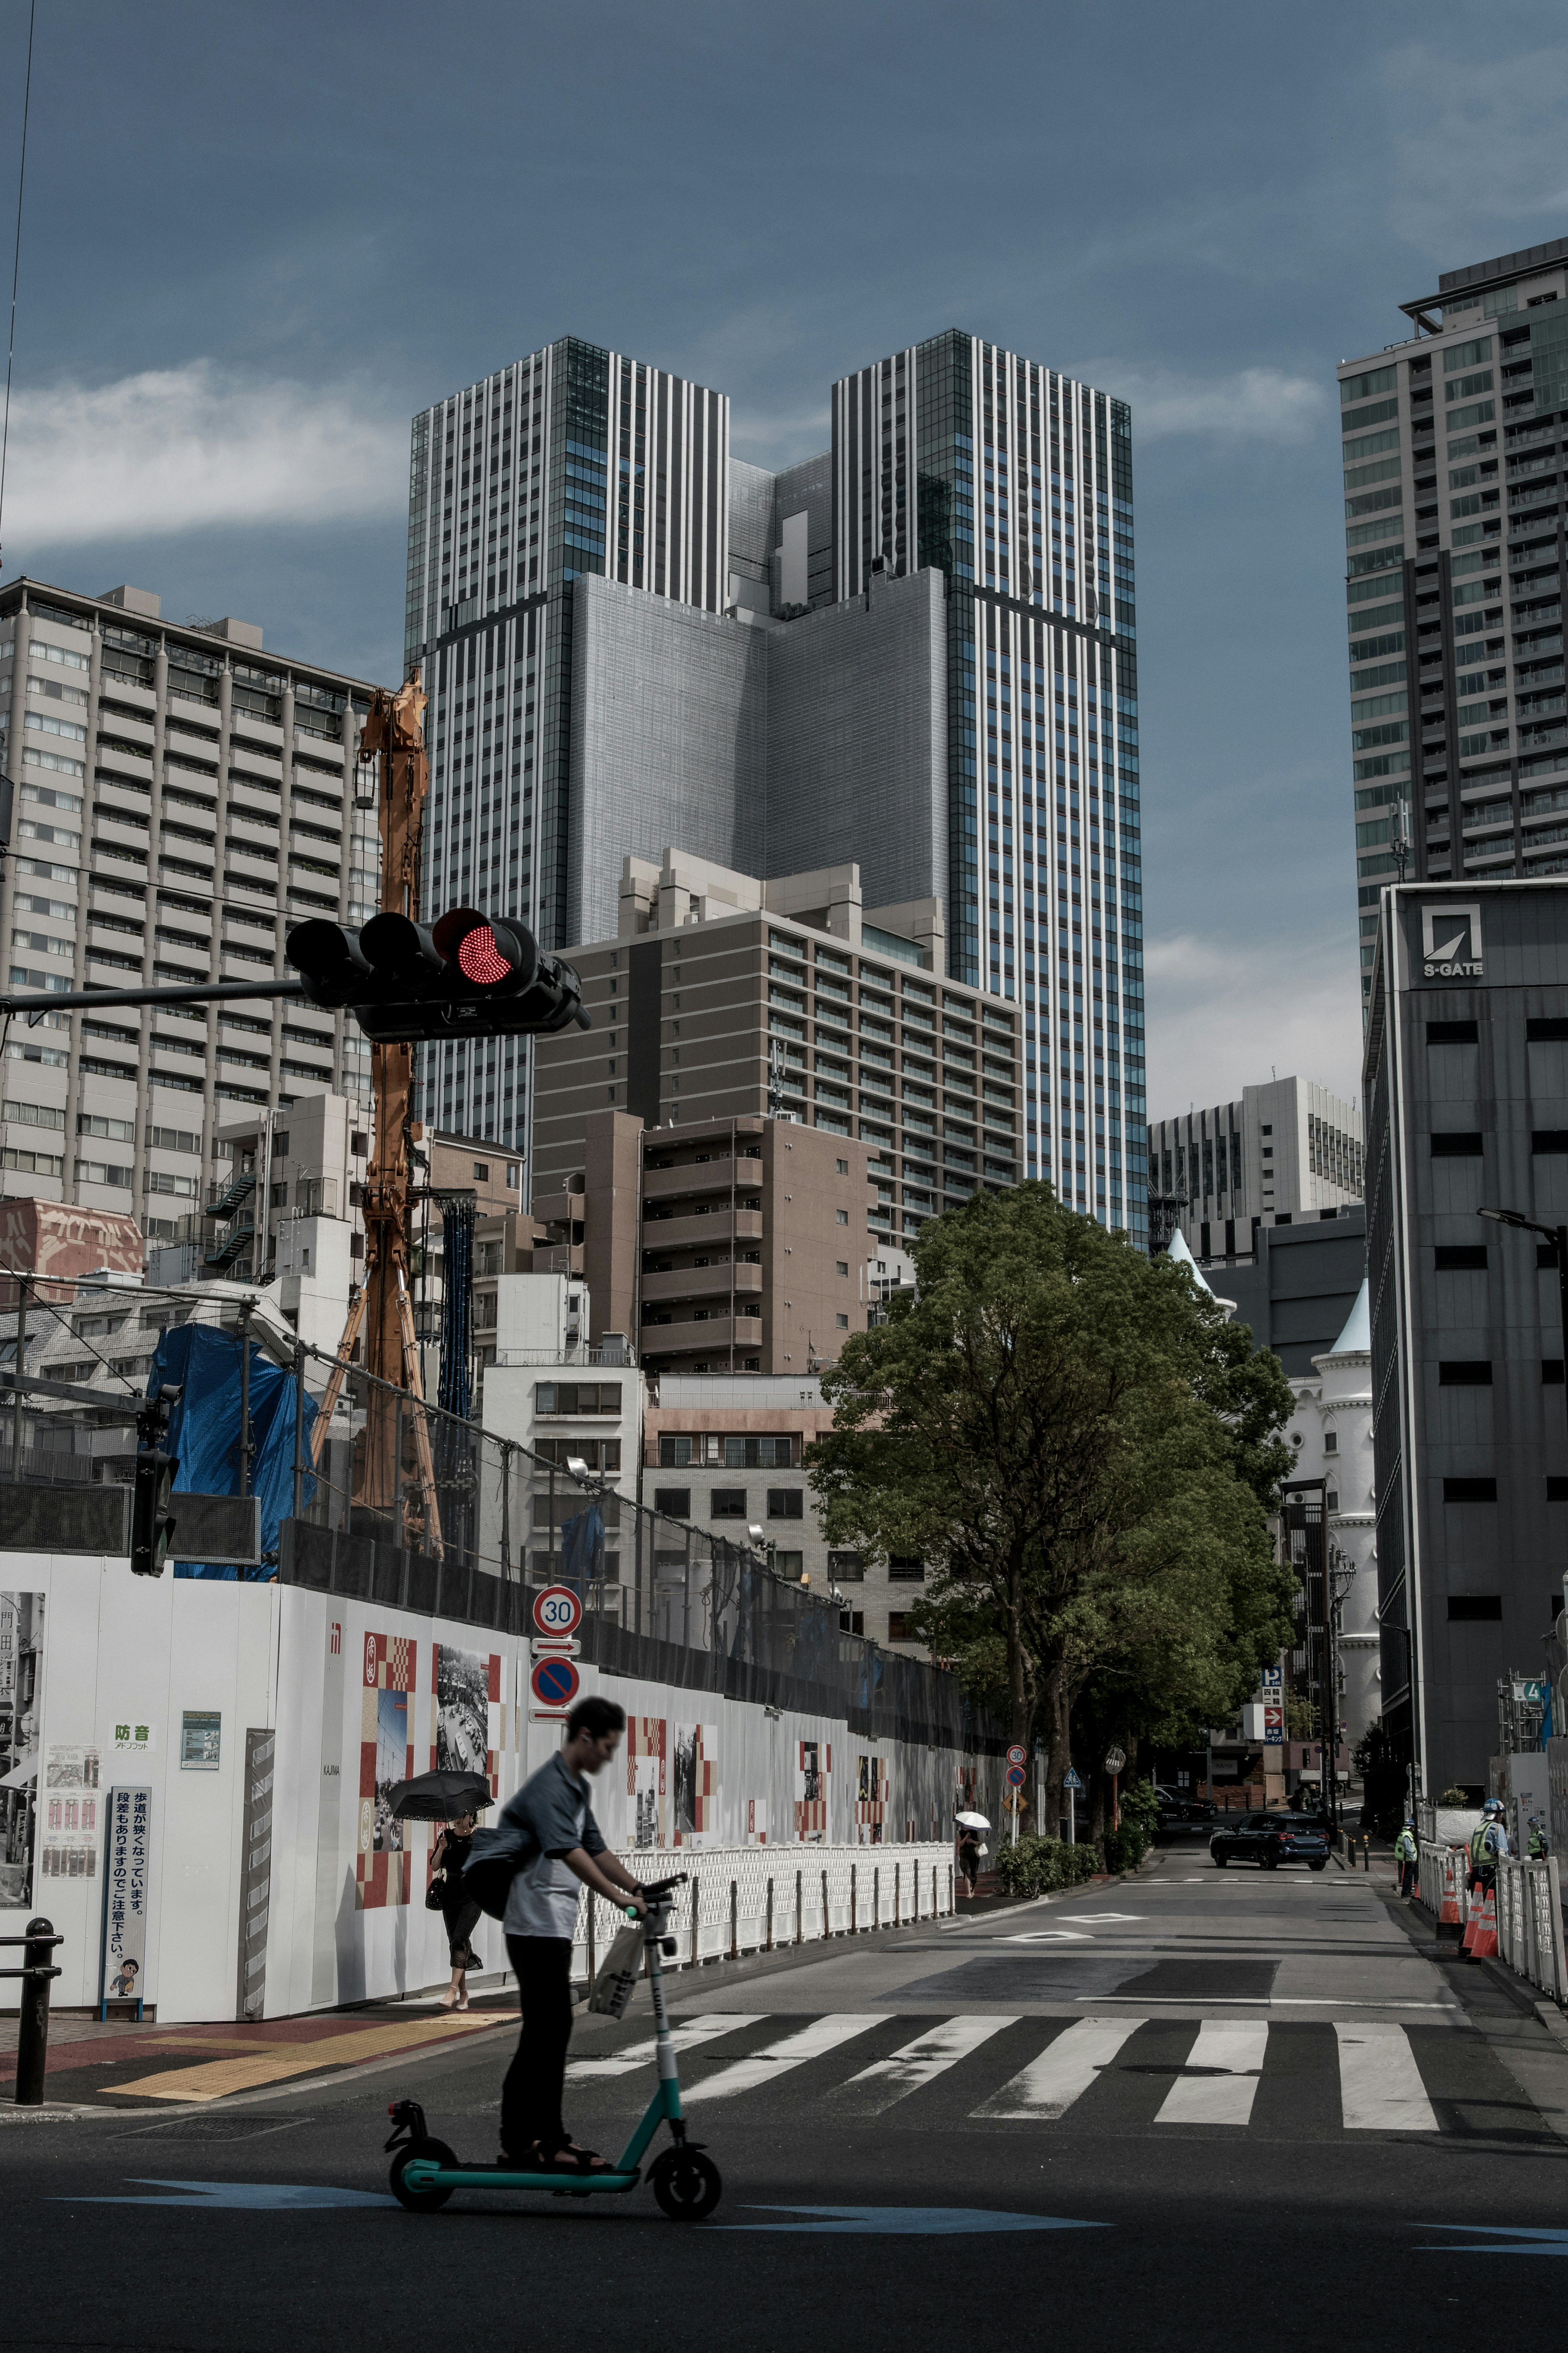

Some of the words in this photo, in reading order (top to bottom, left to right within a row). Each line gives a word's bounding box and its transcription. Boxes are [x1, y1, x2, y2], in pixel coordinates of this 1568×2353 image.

[1424, 962, 1483, 977] S-GATE
[545, 1601, 571, 1623] 30
[1265, 1668, 1279, 1685] P
[1528, 1683, 1539, 1699] 4
[115, 1724, 149, 1741] 防音
[1011, 1751, 1022, 1760] 30
[323, 1764, 340, 1776] KAJIMA
[130, 1792, 147, 1916] 歩道が狭くなっています。
[111, 1792, 129, 1959] 段差もありますのでご注意下さい。
